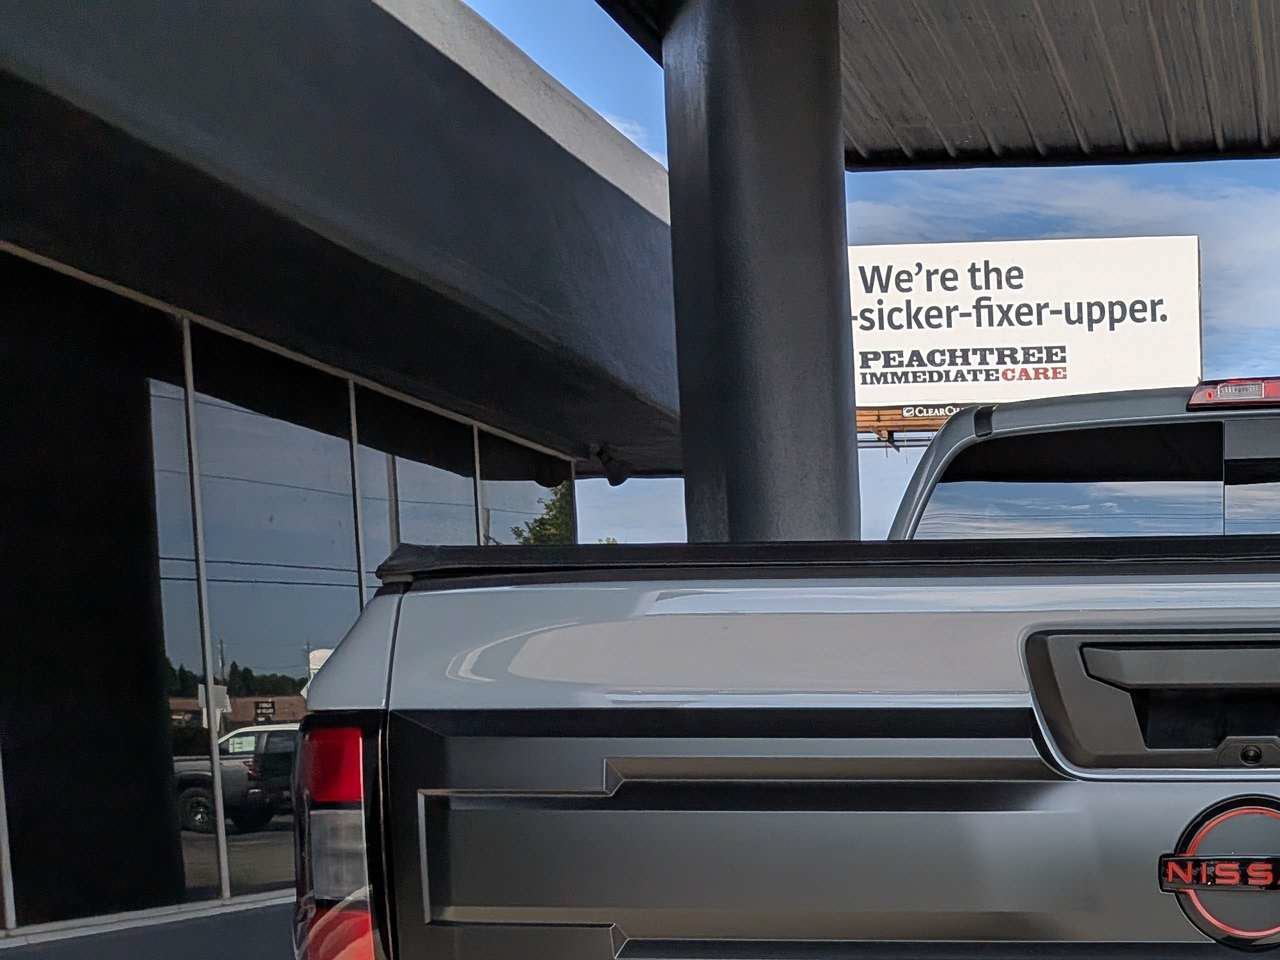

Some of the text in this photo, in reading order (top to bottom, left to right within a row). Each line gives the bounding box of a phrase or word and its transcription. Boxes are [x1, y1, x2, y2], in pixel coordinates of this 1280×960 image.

[858, 260, 1025, 293] We're the
[858, 345, 1067, 369] PEACHTREE
